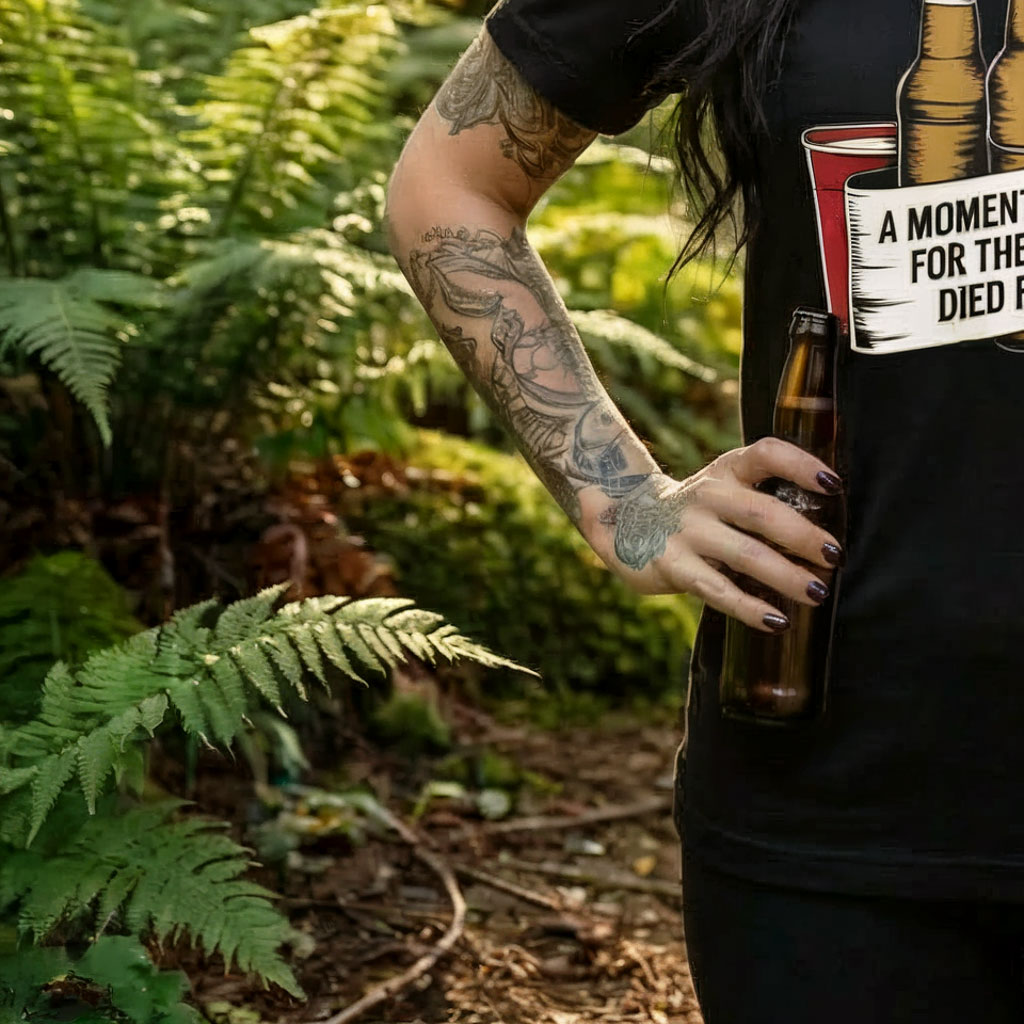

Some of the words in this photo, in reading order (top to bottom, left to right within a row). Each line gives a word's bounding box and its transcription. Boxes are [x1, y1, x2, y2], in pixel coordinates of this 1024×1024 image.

[879, 210, 897, 244] A
[911, 242, 967, 283] FOR
[938, 280, 1005, 323] DIED
